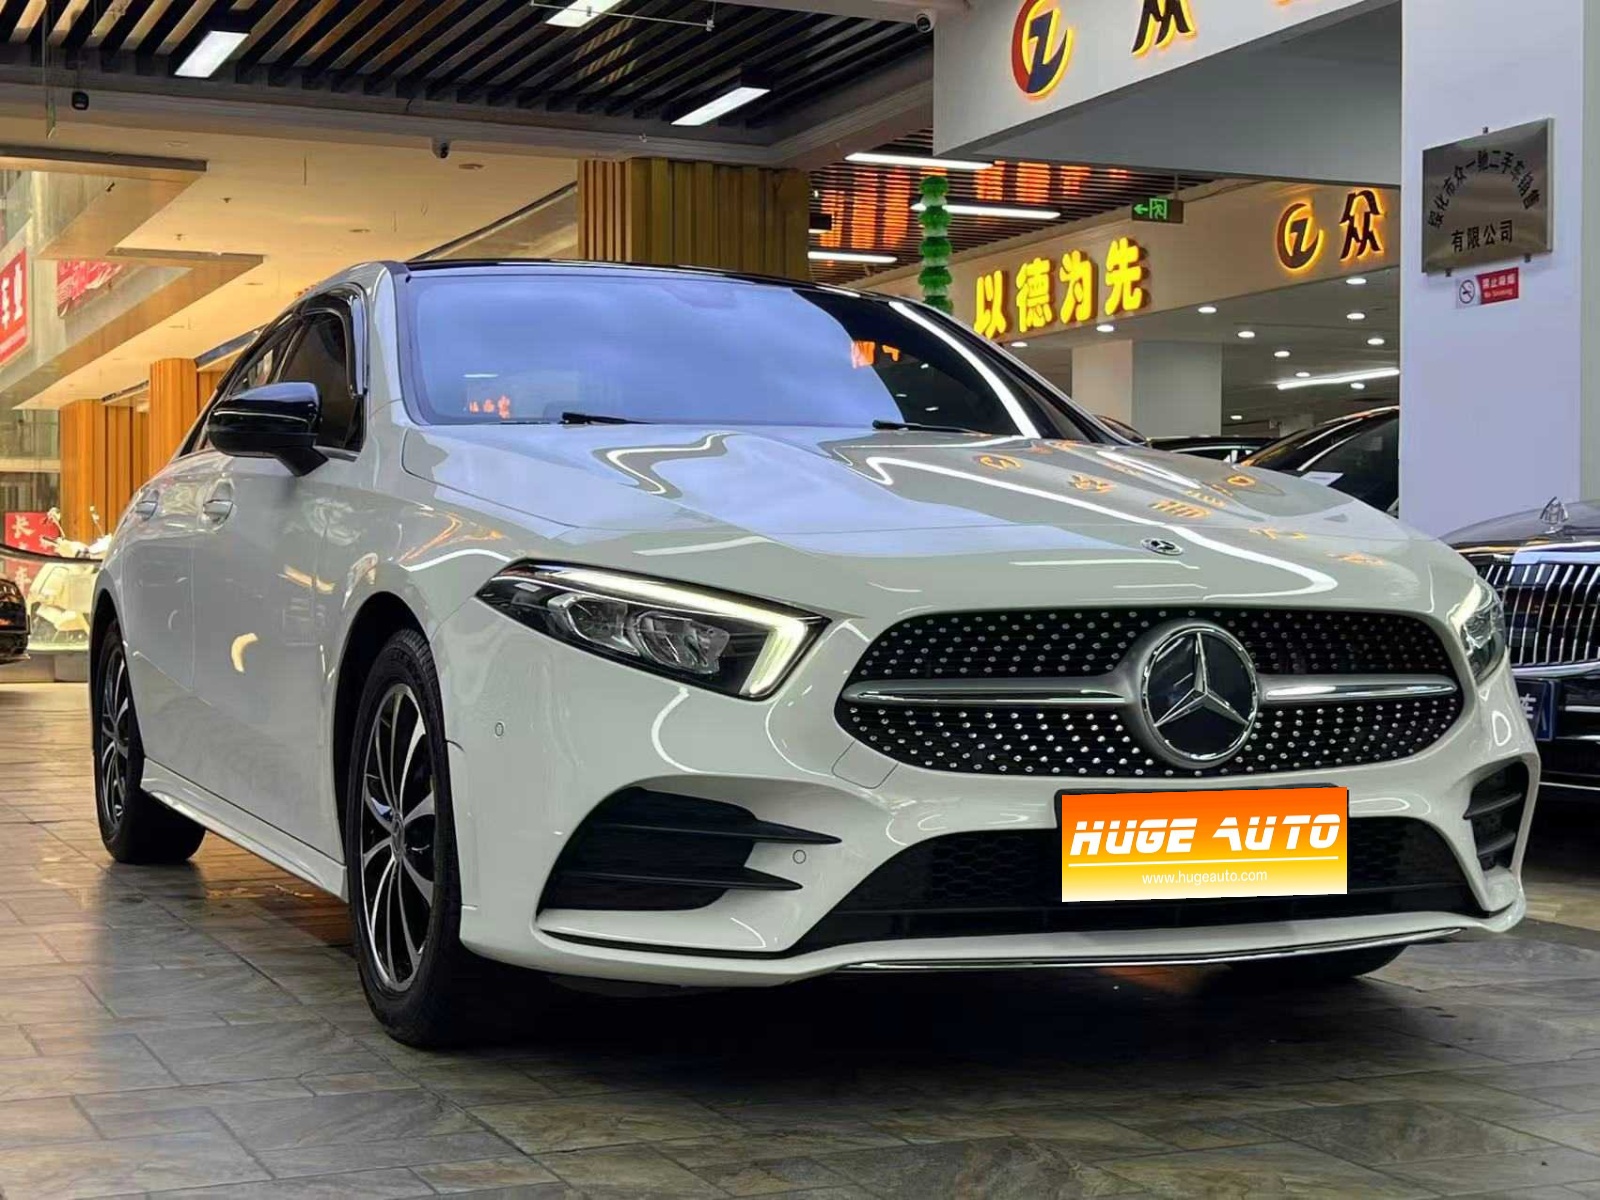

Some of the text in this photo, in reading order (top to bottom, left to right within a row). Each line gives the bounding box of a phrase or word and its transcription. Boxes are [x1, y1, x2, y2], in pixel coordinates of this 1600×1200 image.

[1340, 189, 1384, 261] 众
[1451, 219, 1513, 253] 有限公司
[972, 236, 1143, 339] 以德为先
